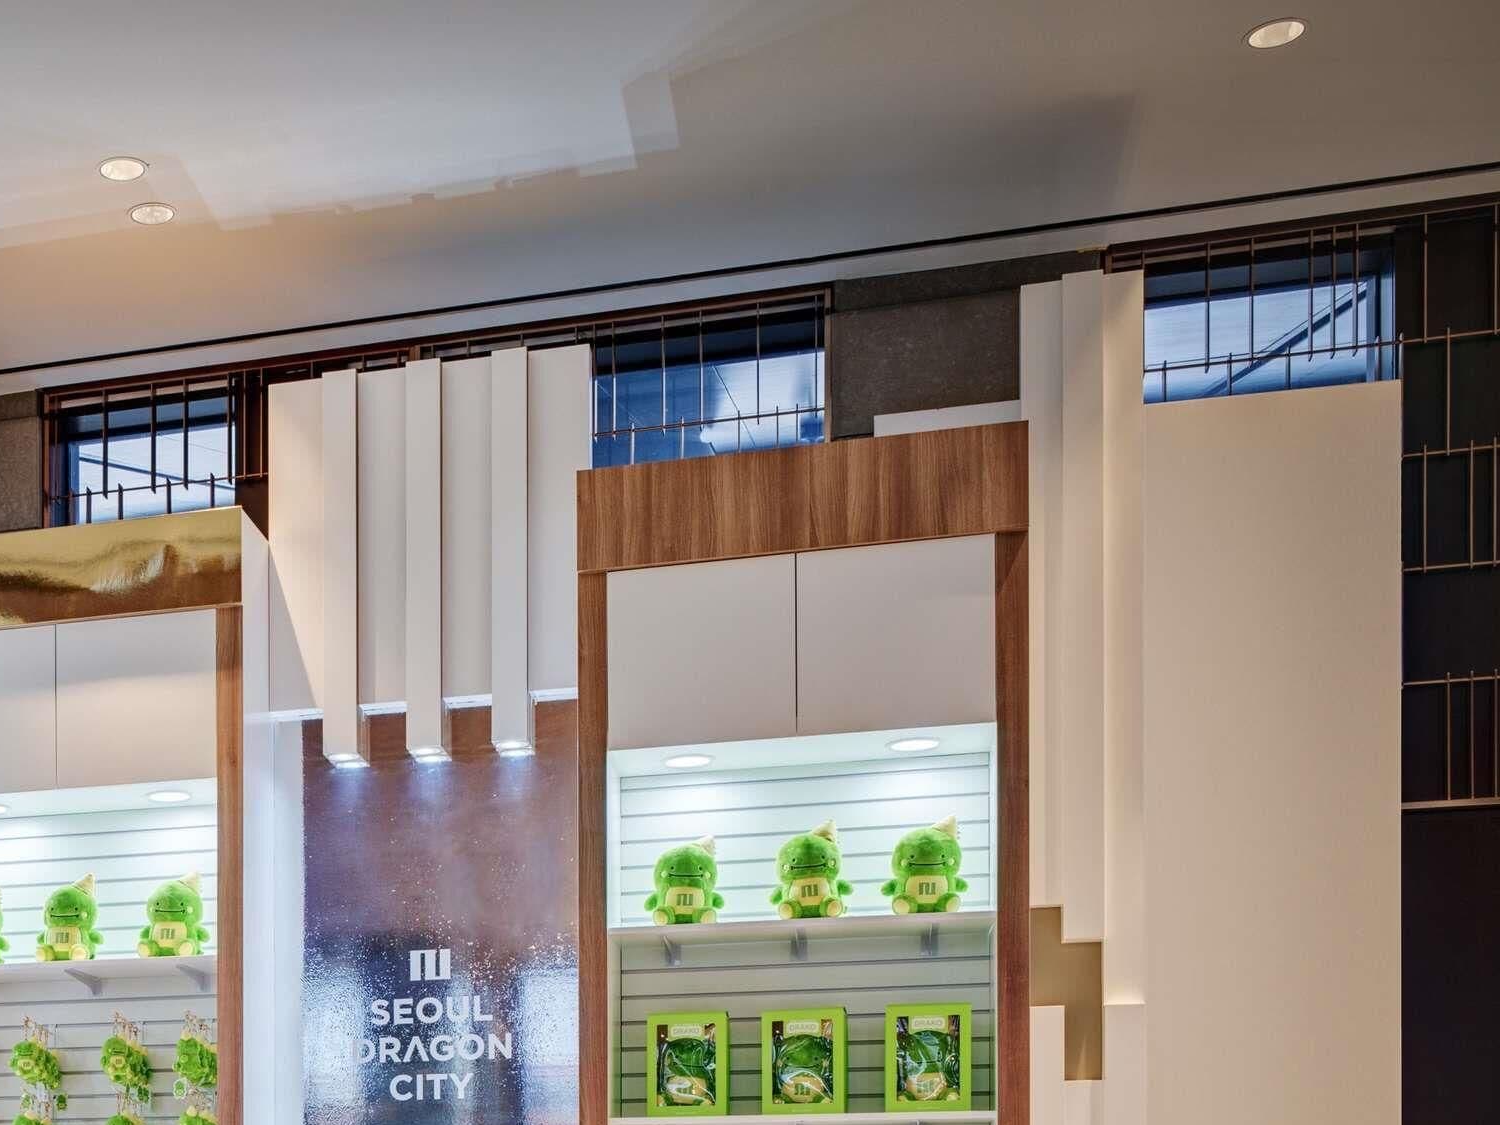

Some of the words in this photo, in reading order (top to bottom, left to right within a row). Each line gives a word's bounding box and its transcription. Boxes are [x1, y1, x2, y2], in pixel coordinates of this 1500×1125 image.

[370, 995, 494, 1026] SEOUL
[353, 1033, 513, 1064] DRAGON
[389, 1073, 474, 1101] CITY
